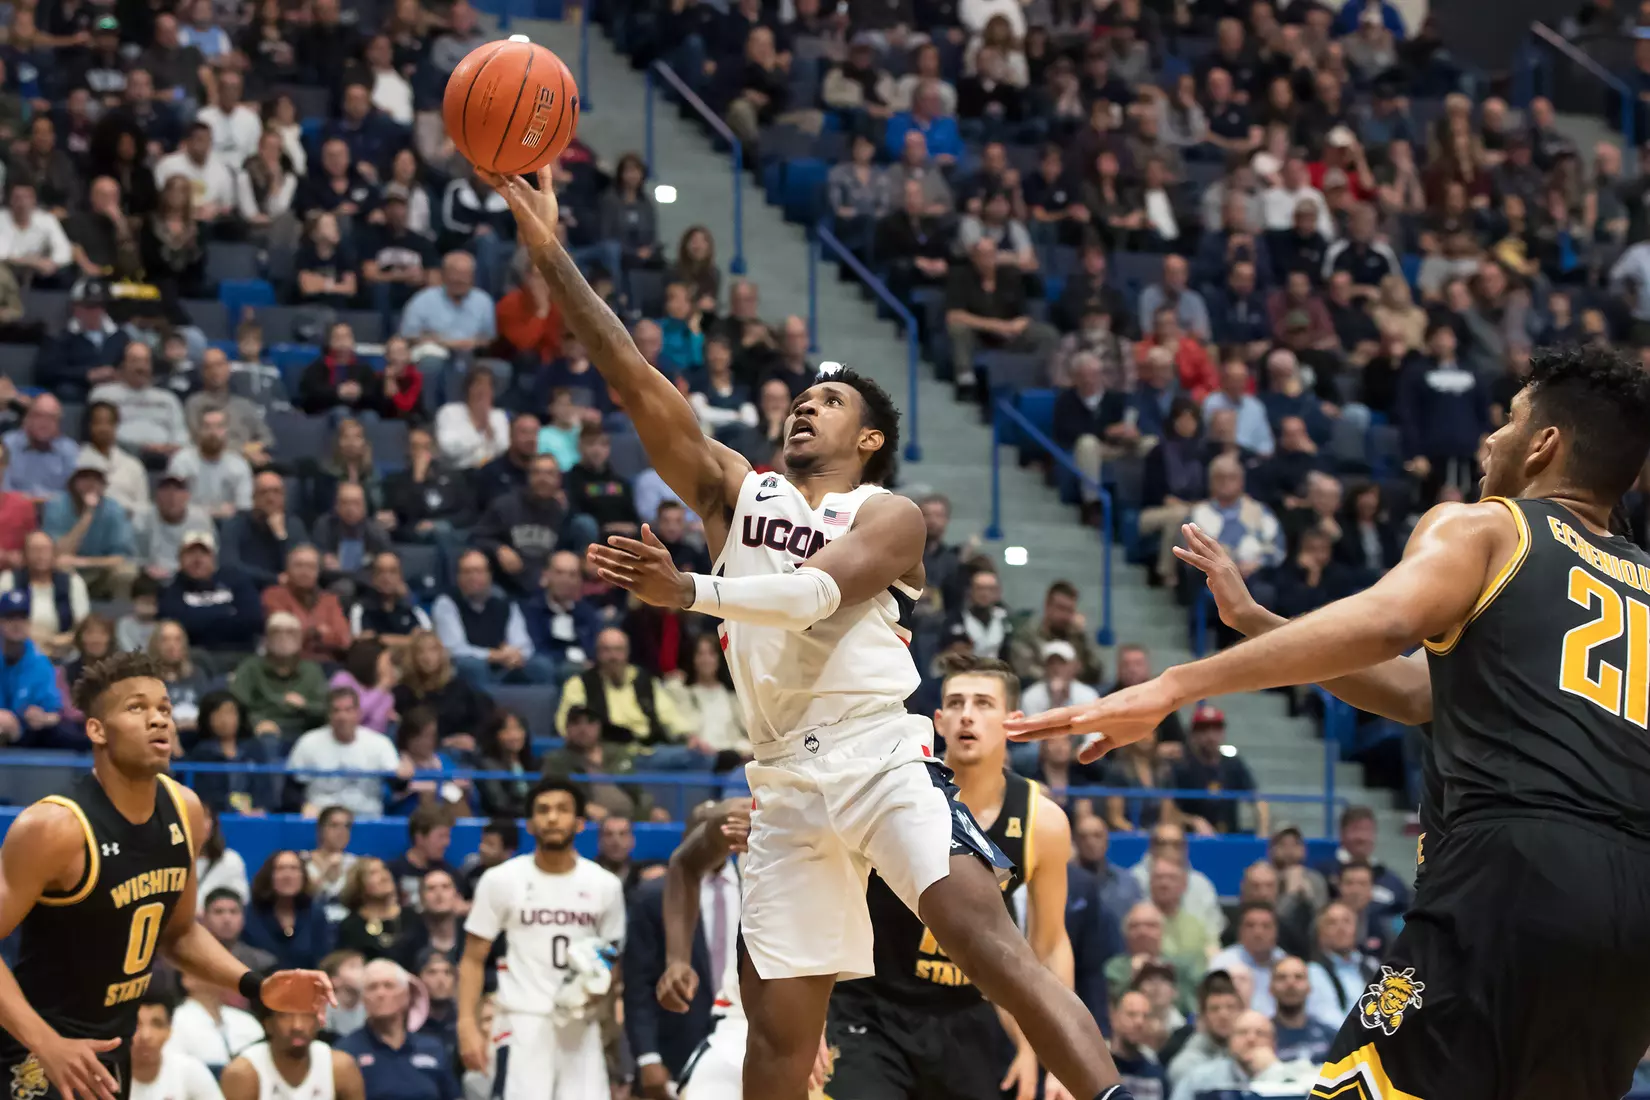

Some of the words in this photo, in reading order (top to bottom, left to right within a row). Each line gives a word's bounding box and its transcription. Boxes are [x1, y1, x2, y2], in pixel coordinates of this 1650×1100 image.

[521, 85, 556, 148] ELITE
[742, 515, 833, 560] UCON
[1559, 565, 1650, 730] 21
[110, 867, 187, 909] WICHITA
[123, 902, 165, 975] 0
